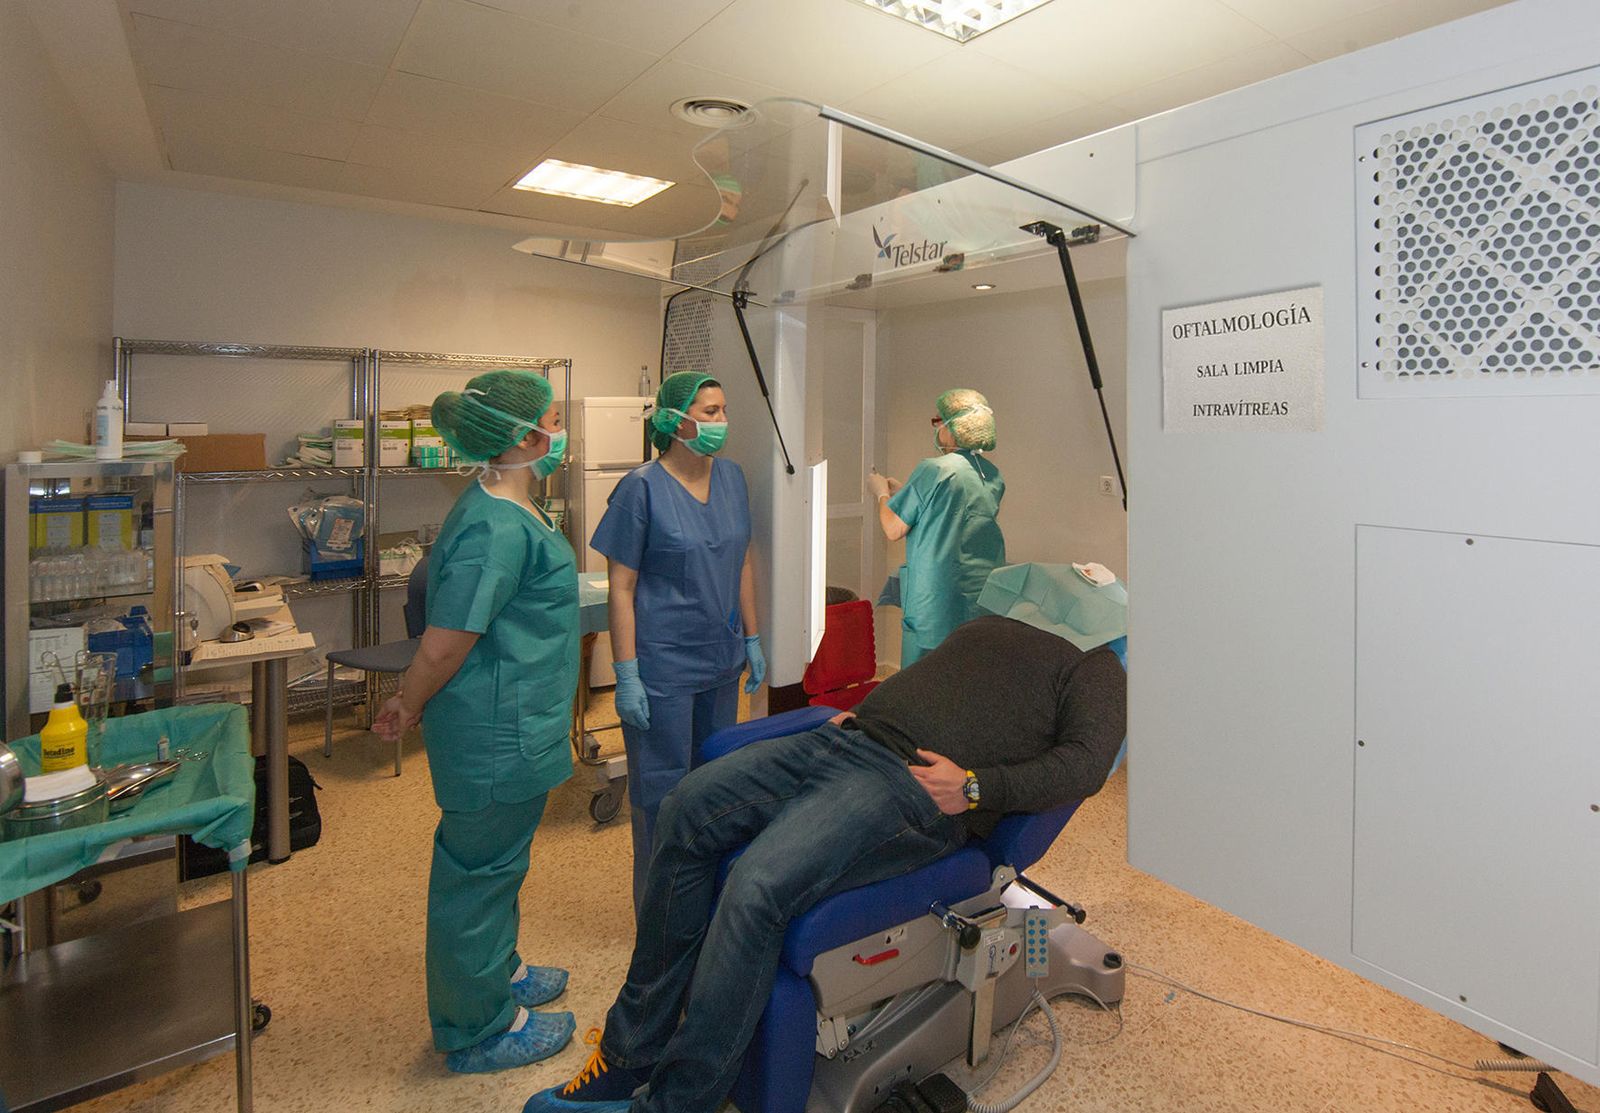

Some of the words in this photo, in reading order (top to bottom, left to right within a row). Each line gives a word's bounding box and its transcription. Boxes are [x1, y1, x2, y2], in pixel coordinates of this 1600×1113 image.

[893, 239, 948, 268] Telstar
[1172, 303, 1312, 340] OFTALMOLOGÍA
[1197, 364, 1229, 378] SALA
[1235, 359, 1284, 376] LIMPIA
[1193, 400, 1289, 417] INTRAVÍTREAS
